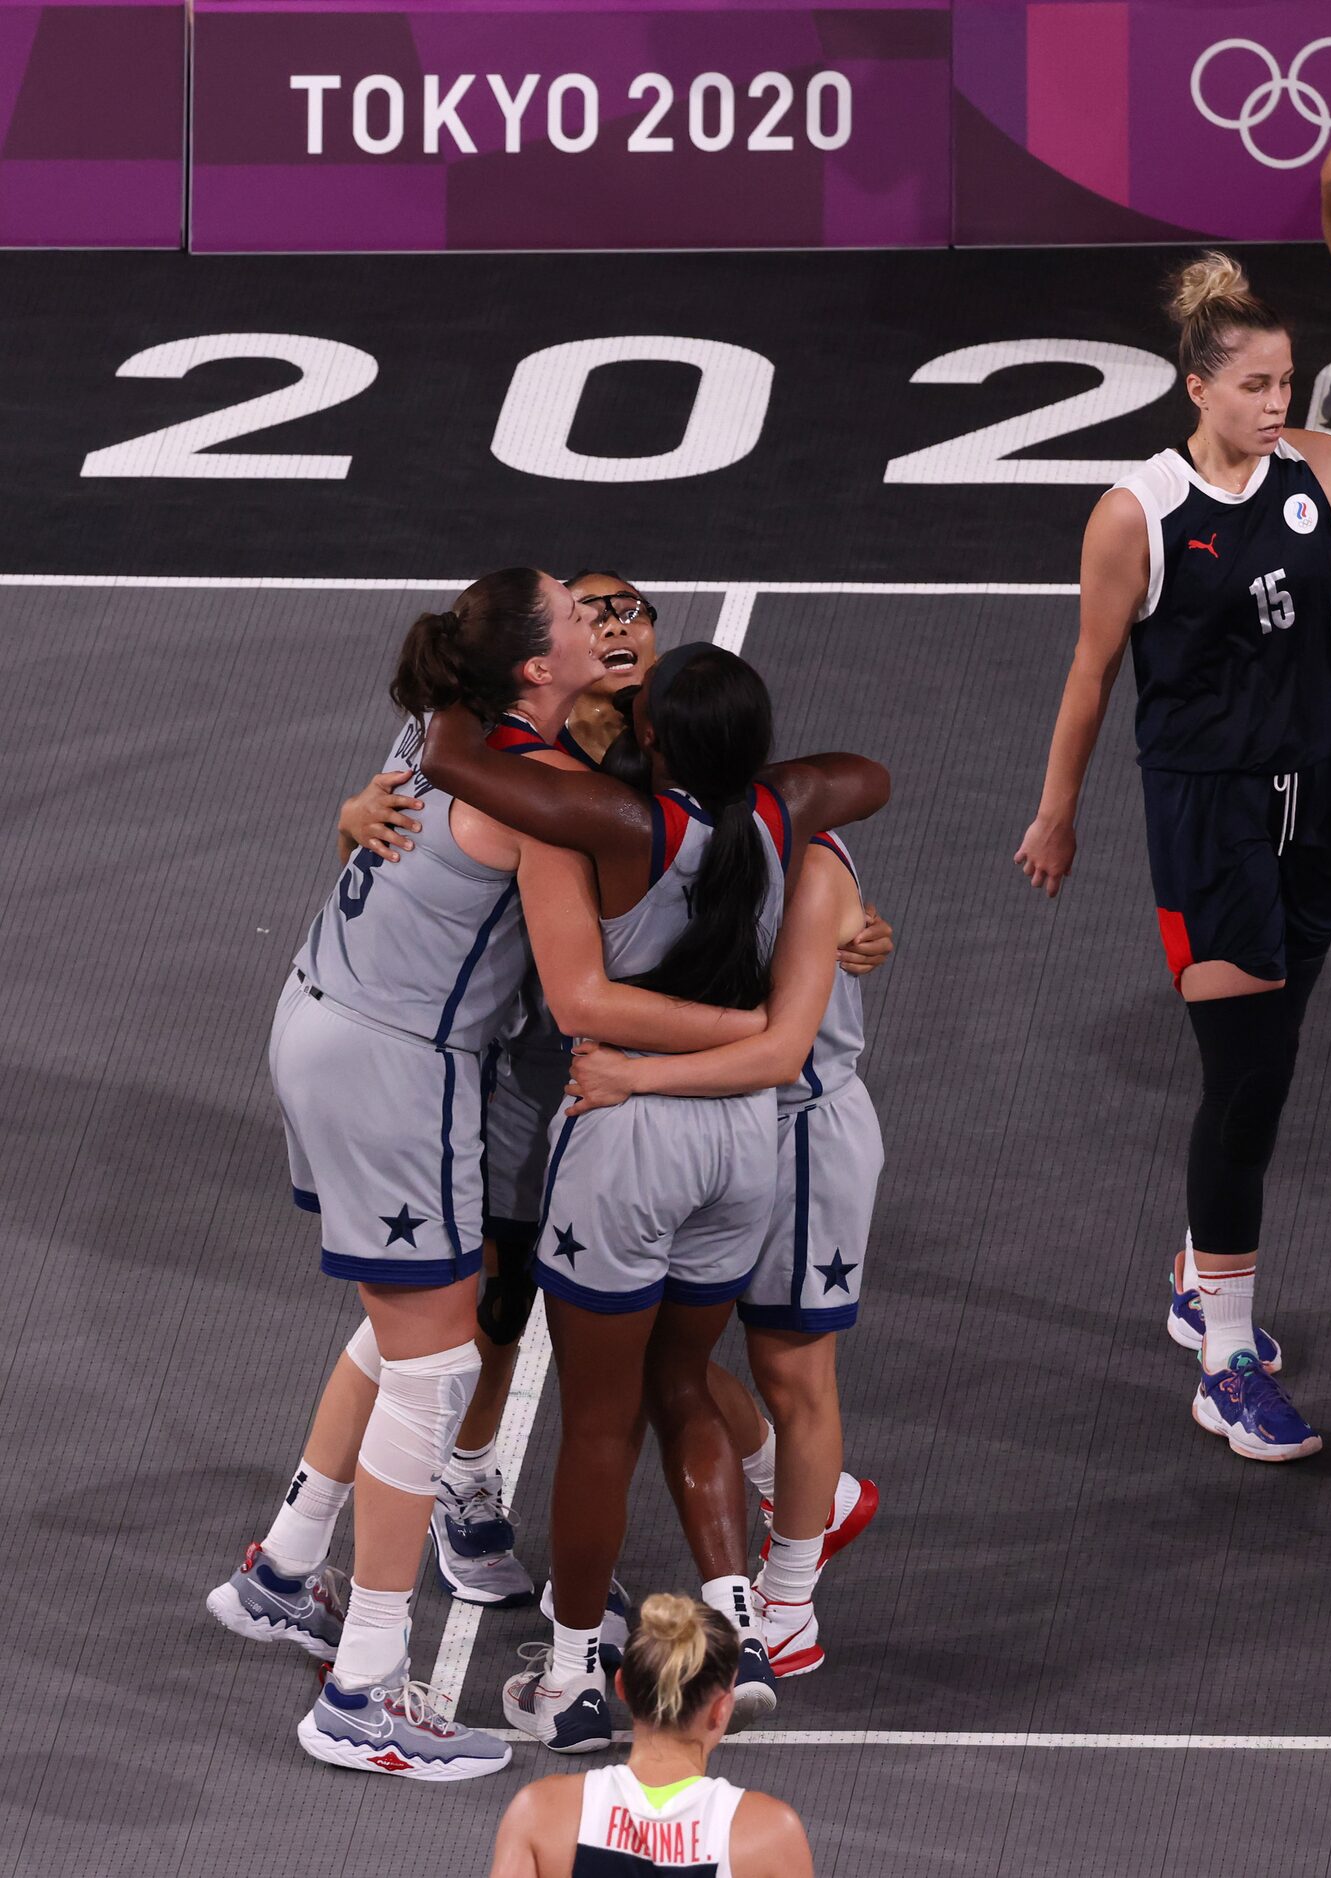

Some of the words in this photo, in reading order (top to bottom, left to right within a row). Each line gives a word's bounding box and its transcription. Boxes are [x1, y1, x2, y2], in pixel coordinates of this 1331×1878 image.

[291, 74, 598, 154] TOKYO
[628, 71, 851, 151] 2020
[1248, 567, 1296, 635] 15
